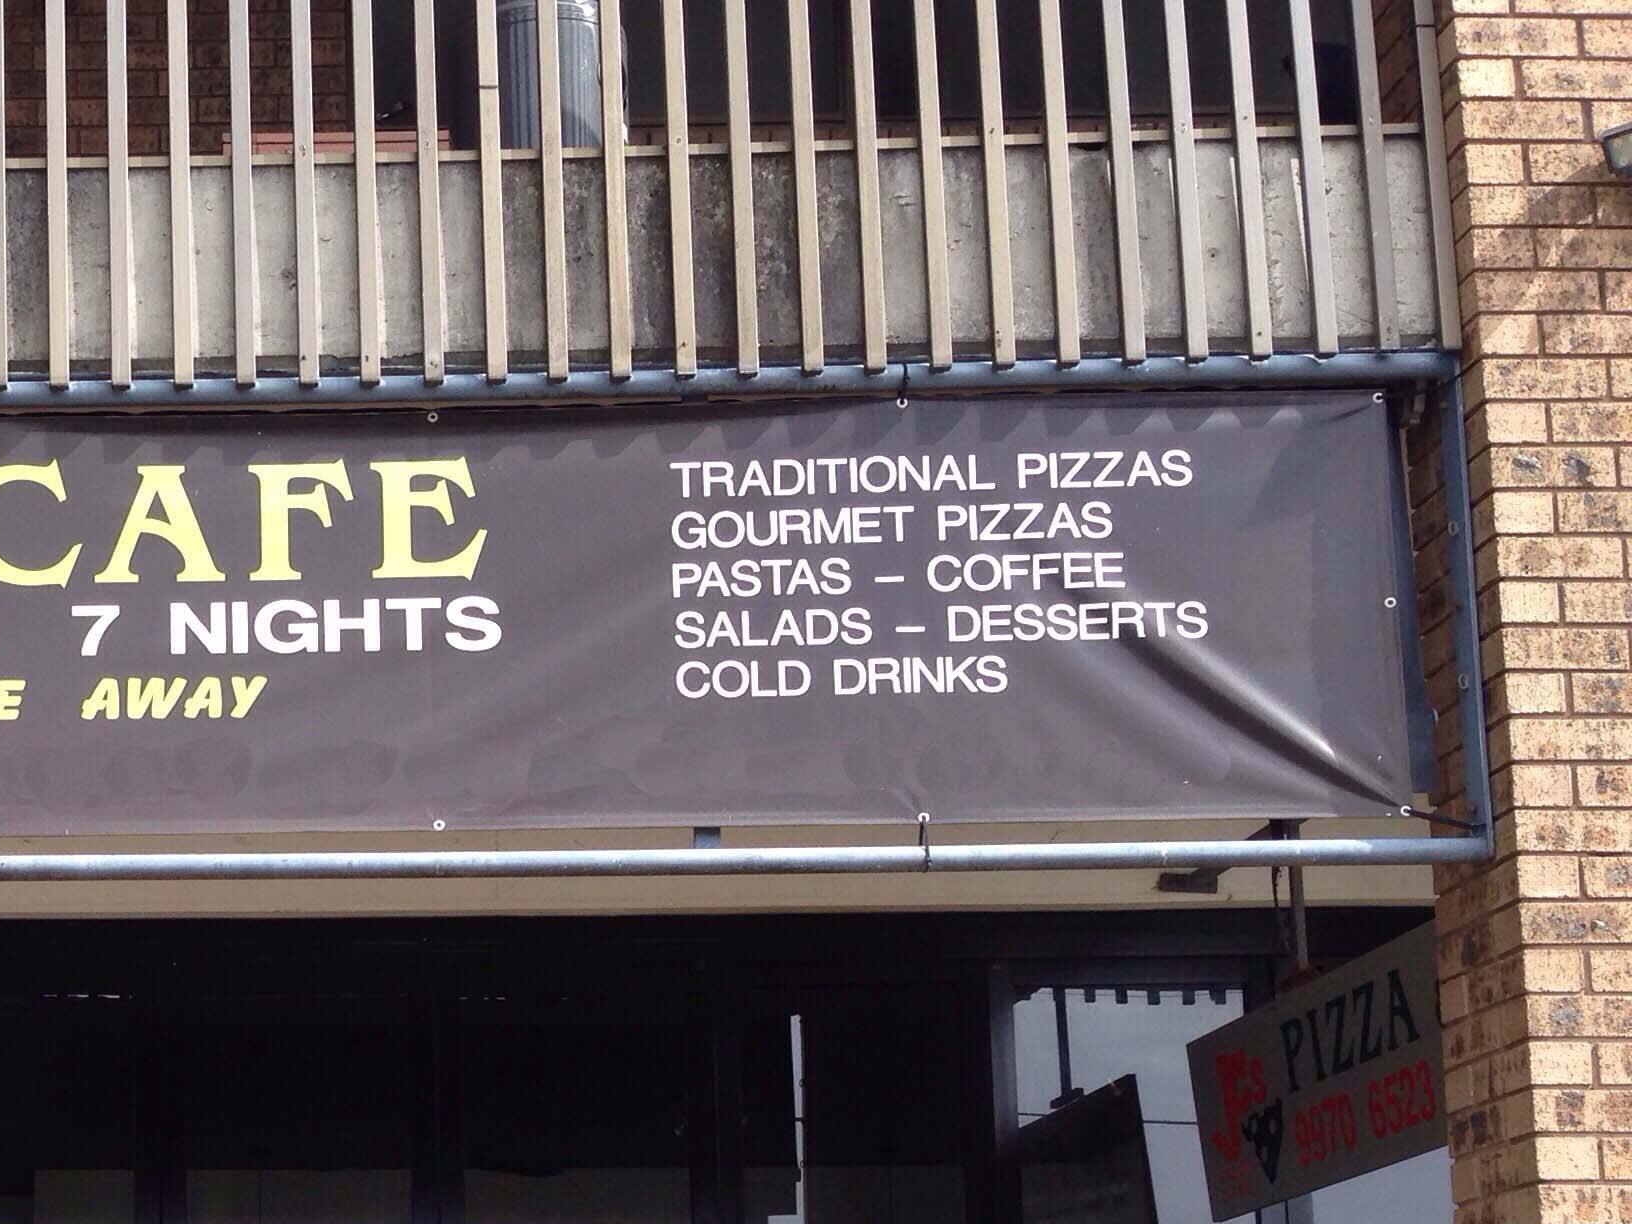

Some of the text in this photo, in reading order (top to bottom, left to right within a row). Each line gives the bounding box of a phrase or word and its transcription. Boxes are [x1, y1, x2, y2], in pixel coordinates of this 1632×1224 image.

[670, 449, 1192, 497] TRADITIONAL PIZZAS
[672, 501, 1112, 549] GOURMET PIZZAS
[672, 557, 851, 598] PASTAS
[927, 551, 1126, 592] COFFEE
[72, 605, 120, 656] 7
[170, 596, 501, 654] NIGHTS
[675, 607, 872, 648] SALADS
[948, 600, 1208, 643] DESSERTS
[82, 676, 267, 720] AWAY
[676, 655, 1008, 698] COLD DRINKS
[1280, 968, 1420, 1094] PIZZA
[1293, 1060, 1437, 1167] 9970 6523
